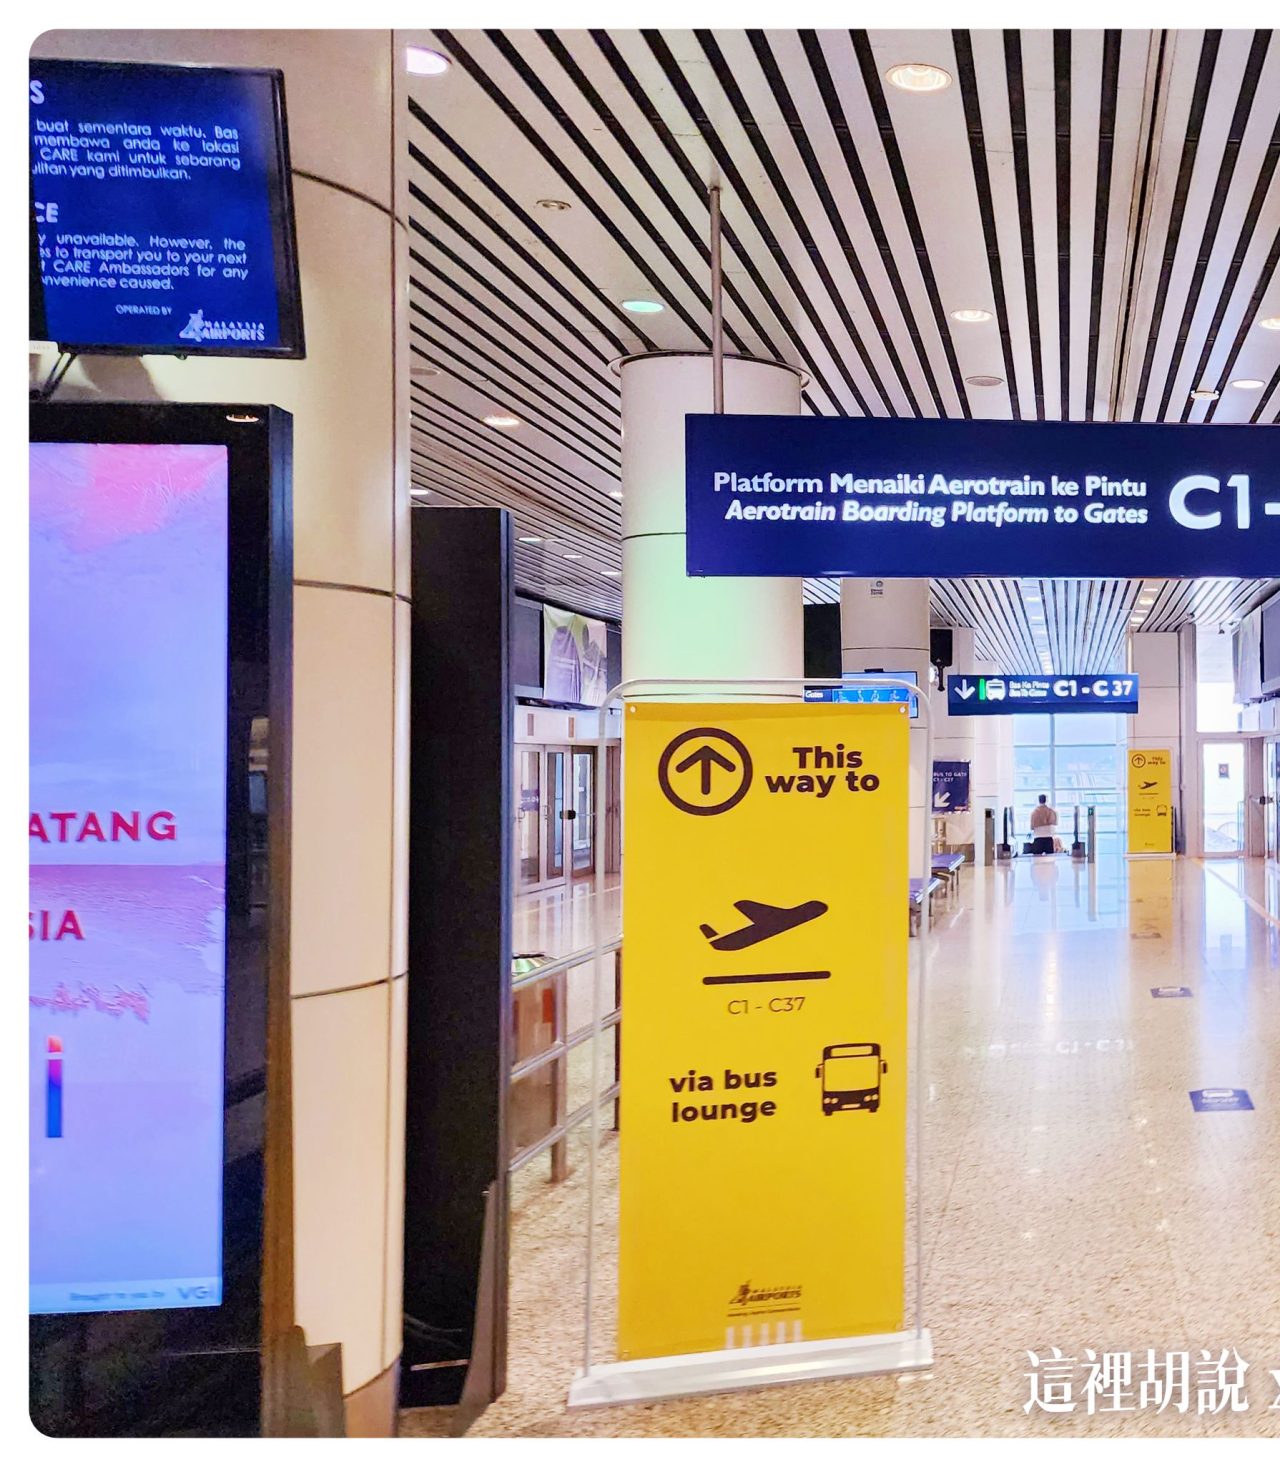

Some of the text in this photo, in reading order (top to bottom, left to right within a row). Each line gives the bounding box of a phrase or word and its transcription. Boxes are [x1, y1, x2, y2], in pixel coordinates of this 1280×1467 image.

[36, 118, 239, 140] buat sementara waktu. Bas
[34, 133, 239, 154] membawa anda ke lokasi
[40, 147, 240, 171] CARE kami untuk sebarang
[69, 164, 105, 180] yang
[108, 163, 191, 181] ditimbulkan.
[55, 245, 69, 259] to
[73, 246, 133, 262] transport
[136, 250, 162, 264] you
[166, 249, 180, 263] to
[184, 251, 215, 265] your
[217, 252, 247, 265] next
[223, 237, 246, 251] the
[53, 259, 91, 273] CARE
[99, 261, 190, 277] Ambassadors
[196, 263, 216, 277] for
[222, 267, 249, 281] any
[119, 277, 174, 290] caused.
[115, 304, 172, 316] OPERATED BY
[714, 472, 1147, 498] Platform Menaiki Aerotrain ke Pintu
[725, 499, 1149, 528] Aerotrain Boarding Platform to Gates
[1053, 679, 1077, 697] C1
[792, 743, 863, 769] This
[765, 771, 880, 798] way to
[29, 810, 177, 842] ATANG
[727, 1000, 749, 1015] C1
[768, 996, 806, 1013] C37
[669, 1069, 777, 1093] via bus
[672, 1100, 777, 1123] lounge
